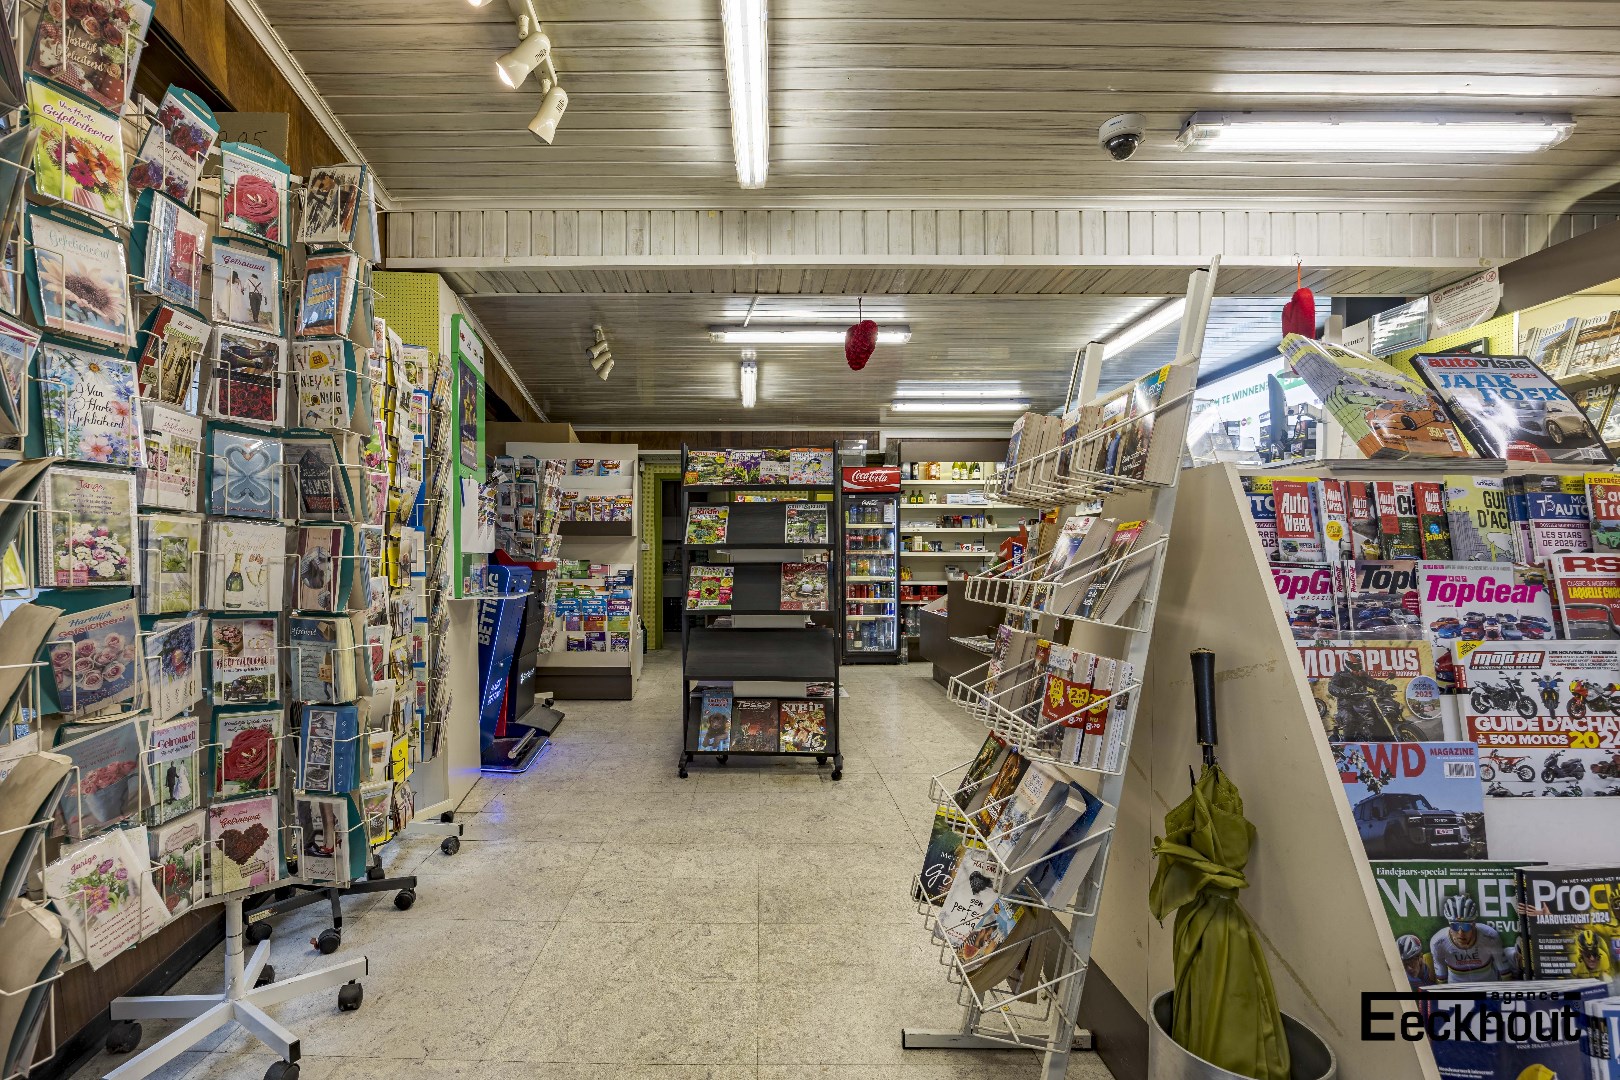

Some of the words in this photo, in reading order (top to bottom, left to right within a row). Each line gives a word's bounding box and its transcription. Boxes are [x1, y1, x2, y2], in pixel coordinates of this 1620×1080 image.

[1428, 357, 1531, 369] autovisie
[1438, 374, 1519, 389] JAAR
[87, 384, 105, 398] Van
[1222, 394, 1231, 404] TE
[88, 399, 114, 414] Harte
[1327, 489, 1341, 501] Auto
[1380, 493, 1395, 505] Auto
[1425, 491, 1440, 503] Auto
[1281, 493, 1309, 514] Auto
[1328, 501, 1343, 512] Week
[1353, 498, 1367, 508] Auto
[1381, 504, 1396, 514] Week
[1427, 502, 1441, 512] Week
[1354, 508, 1368, 518] Week
[1283, 514, 1311, 532] Week
[1554, 540, 1588, 548] 2025/26
[1271, 568, 1334, 599] opG
[1426, 575, 1544, 607] TopGear
[1568, 587, 1602, 599] LAQUELLE
[68, 611, 113, 627] Hartelijk
[1304, 650, 1420, 677] MOTPLUS
[1475, 717, 1539, 731] GUIDE
[1490, 734, 1515, 744] 500
[1519, 735, 1568, 744] MOTOS
[1376, 867, 1448, 877] Eindejaars-special
[1537, 914, 1589, 924] JAAROVERZICHT
[1591, 912, 1610, 922] 2024
